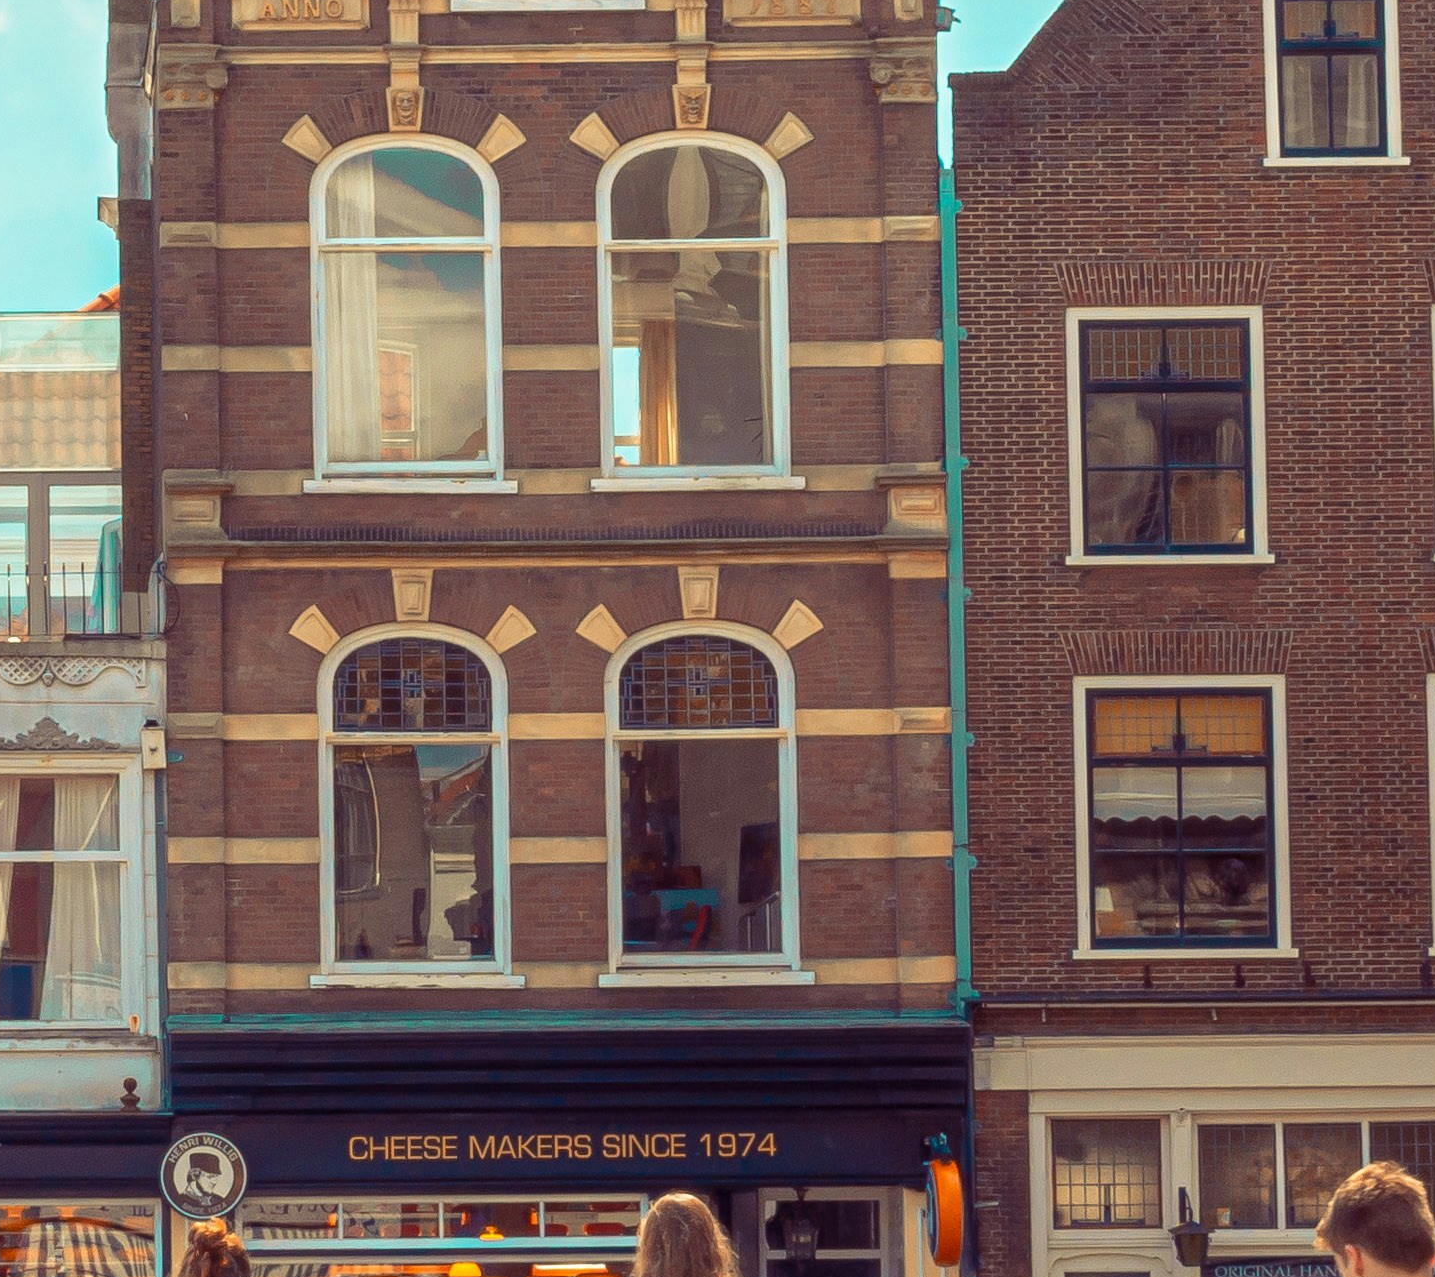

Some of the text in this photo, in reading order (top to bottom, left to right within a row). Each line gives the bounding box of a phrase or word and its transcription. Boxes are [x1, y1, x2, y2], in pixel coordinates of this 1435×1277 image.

[169, 1136, 238, 1163] HENRI WILLIG
[349, 1133, 777, 1160] CHEESE MAKERS SINCE 1974
[1214, 1264, 1296, 1277] ORIGINAL
